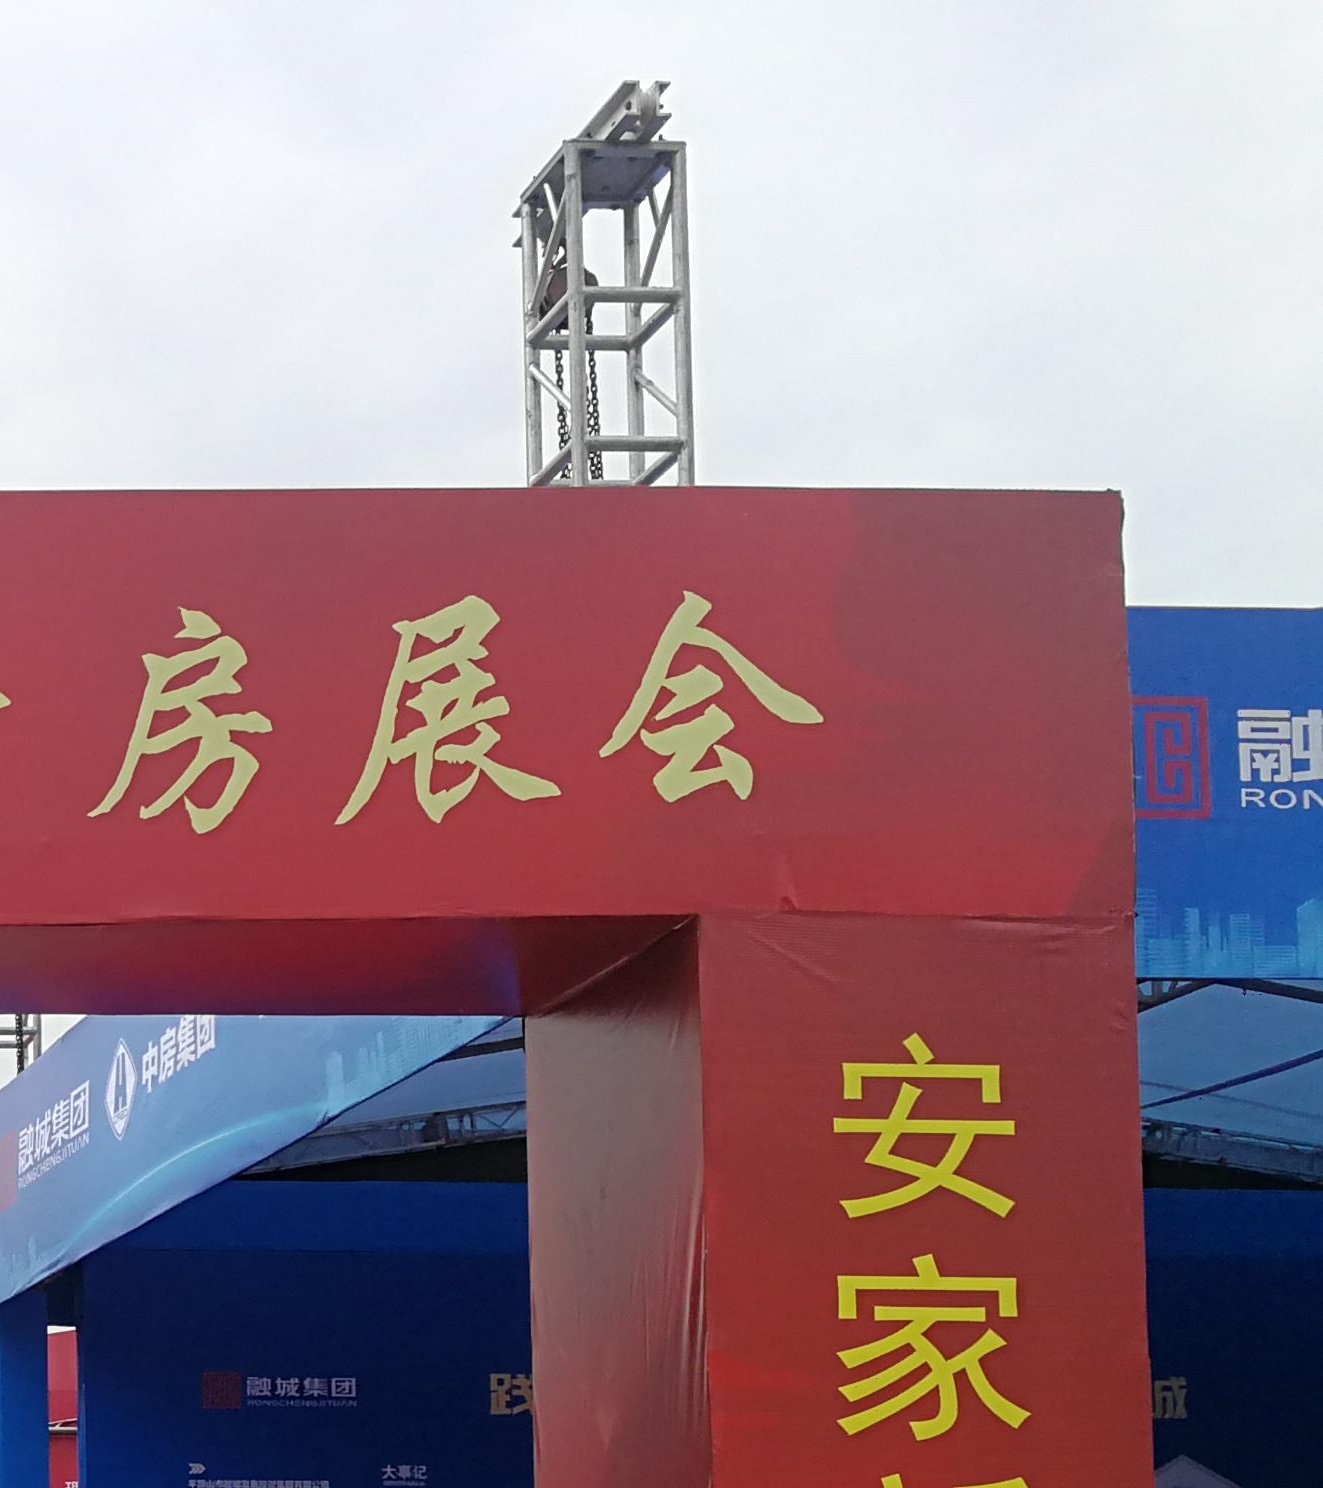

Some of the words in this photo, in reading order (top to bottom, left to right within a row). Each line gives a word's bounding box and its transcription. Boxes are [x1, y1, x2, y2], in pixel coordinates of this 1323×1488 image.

[142, 1014, 216, 1094] 中房集团
[18, 1079, 90, 1176] 融城集团
[246, 1377, 356, 1398] 融城集团
